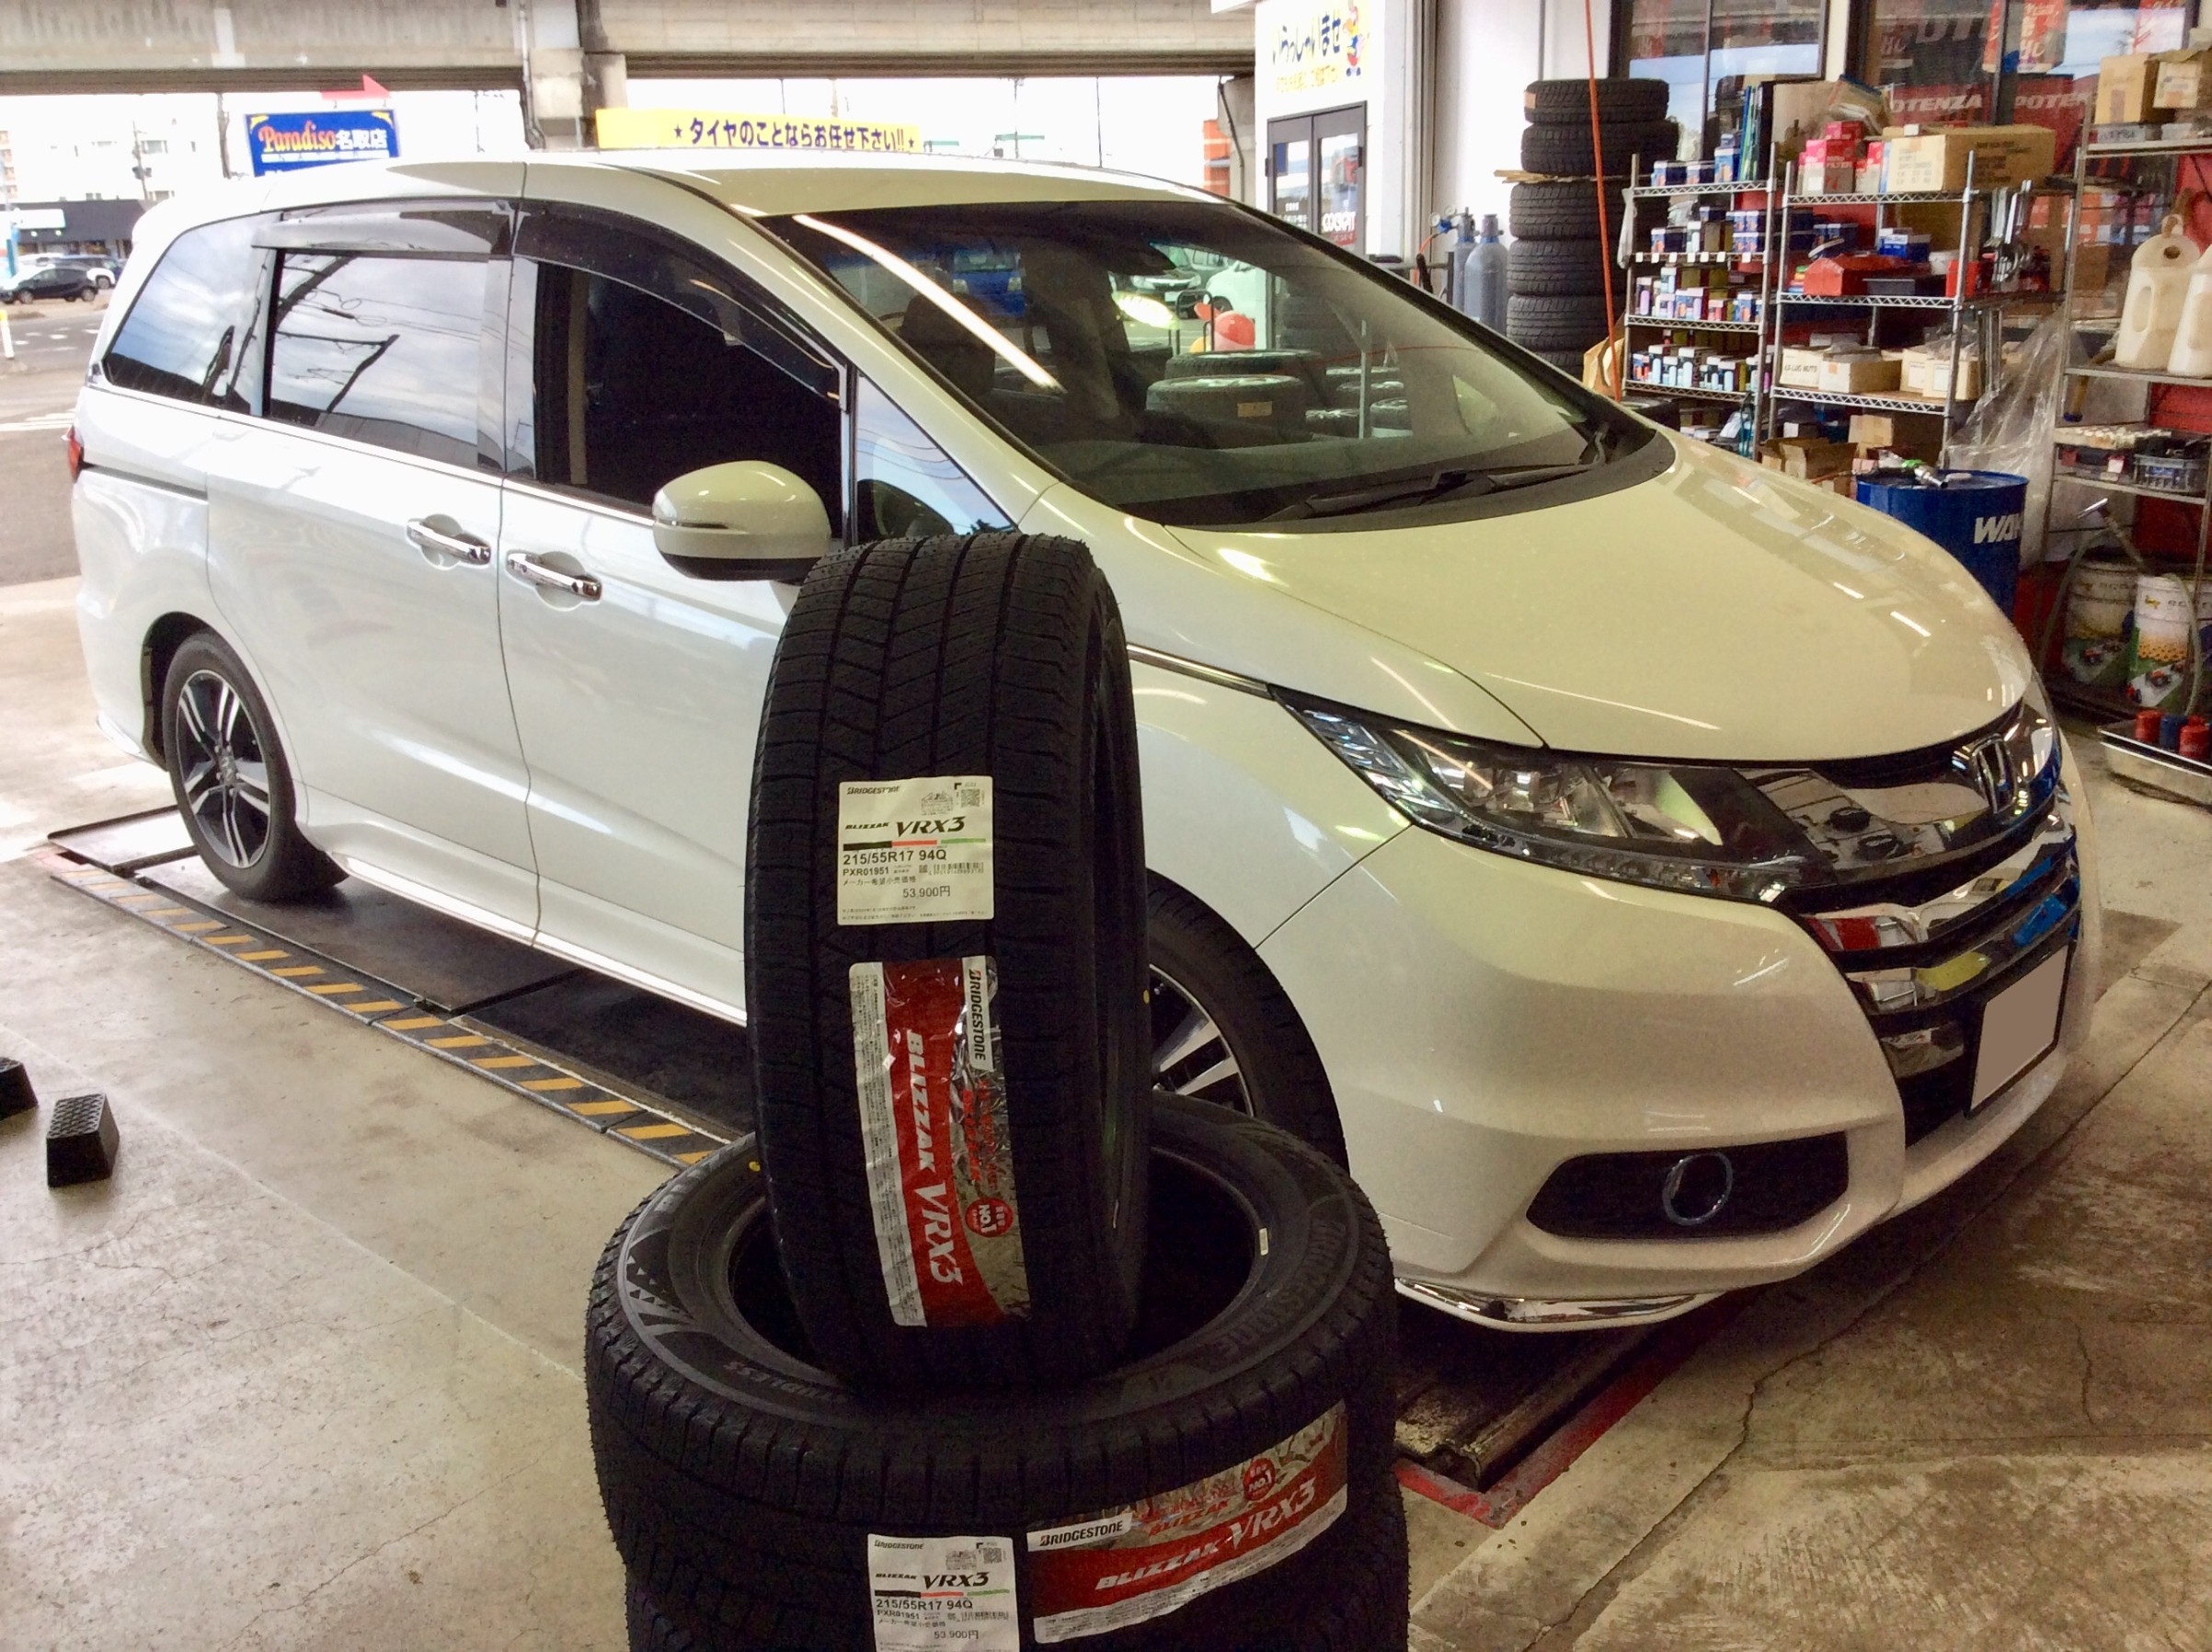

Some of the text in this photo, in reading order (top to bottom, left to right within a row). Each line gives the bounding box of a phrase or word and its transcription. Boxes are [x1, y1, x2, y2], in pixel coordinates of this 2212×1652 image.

[1891, 94, 1982, 113] OTENZA
[258, 120, 336, 153] Paradiso
[896, 816, 966, 837] VRX3
[843, 849, 946, 866] 215/55R17 94Q
[968, 969, 987, 1061] BRIDGESTONE
[906, 1028, 963, 1287] BLIZZAK VRX3
[1040, 1520, 1123, 1547] BRIDGESTONE
[1095, 1540, 1221, 1589] BLIZZAK
[1228, 1475, 1316, 1550] VRX3
[923, 1571, 990, 1589] VRX3
[876, 1599, 973, 1611] 215/55R17 94Q
